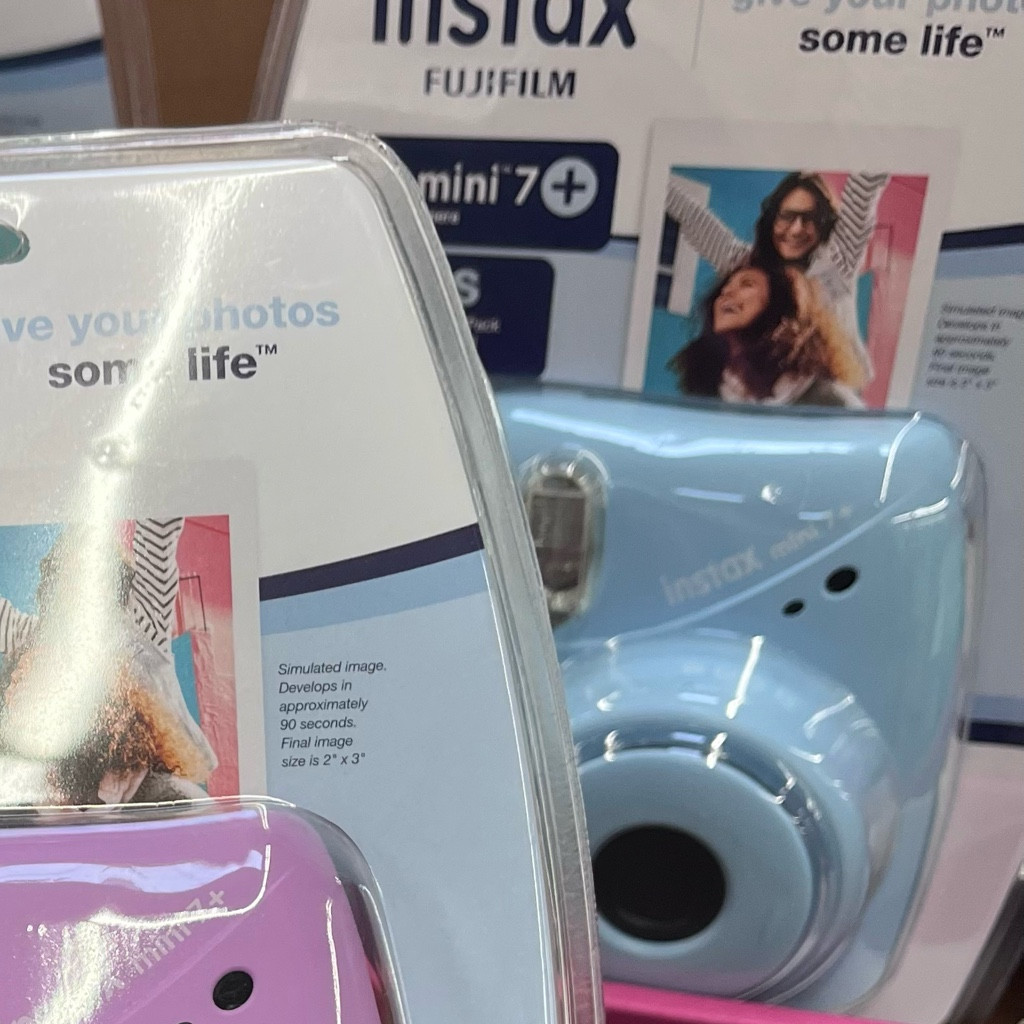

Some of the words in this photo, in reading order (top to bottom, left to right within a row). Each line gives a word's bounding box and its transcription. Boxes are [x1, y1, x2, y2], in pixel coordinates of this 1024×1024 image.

[798, 27, 908, 54] some
[424, 67, 576, 99] FUJIFILM
[48, 355, 138, 389] som
[278, 661, 342, 675] Simulated
[345, 661, 387, 674] image.
[279, 681, 338, 694] Develops
[341, 680, 352, 692] in
[279, 697, 369, 714] approximately
[280, 718, 297, 731] 90
[300, 716, 356, 730] seconds.
[281, 736, 311, 750] Final
[314, 736, 353, 750] image
[281, 756, 306, 768] size
[309, 754, 319, 766] is
[340, 755, 349, 765] x
